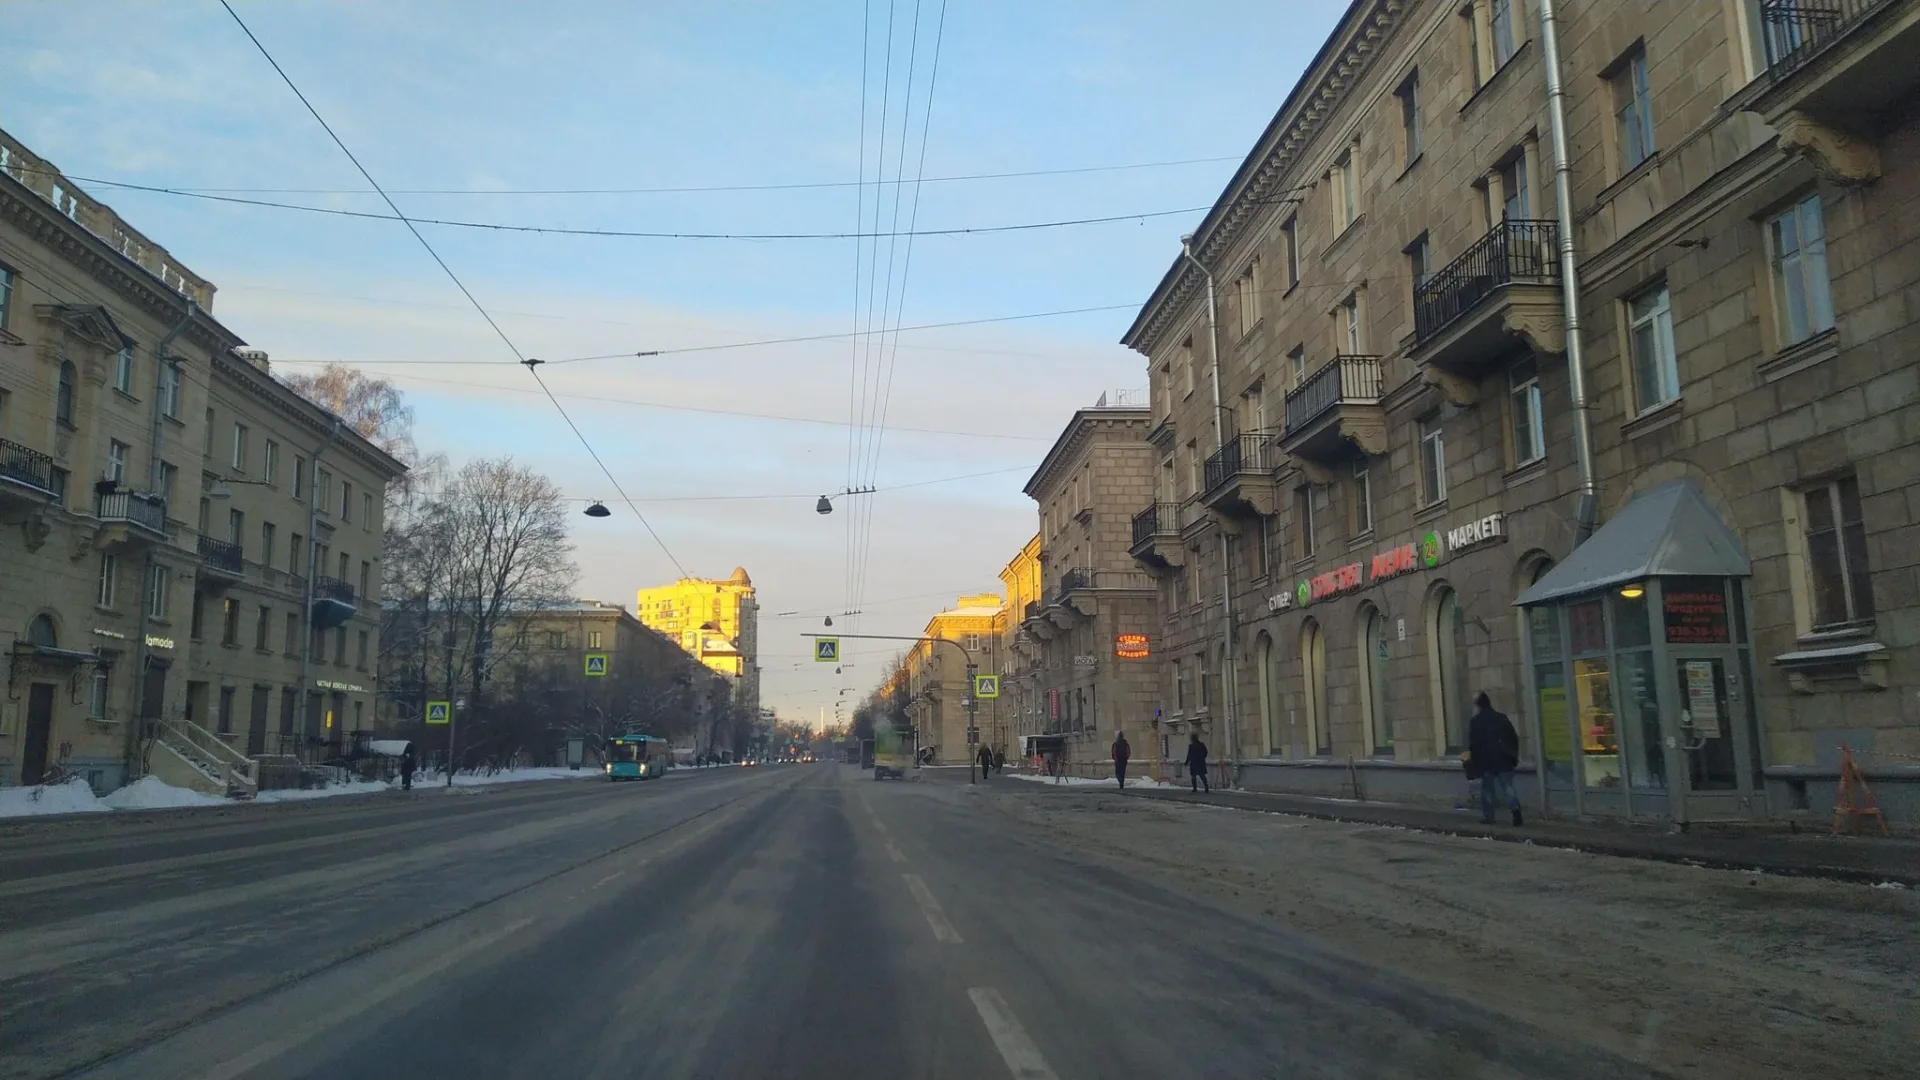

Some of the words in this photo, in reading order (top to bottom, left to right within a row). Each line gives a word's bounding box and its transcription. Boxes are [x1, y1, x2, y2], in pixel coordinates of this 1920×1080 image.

[1425, 540, 1436, 559] 24
[1447, 513, 1502, 551] МАРКЕТ
[145, 633, 174, 649] lamoda
[1117, 650, 1149, 658] КРАСОТЫ
